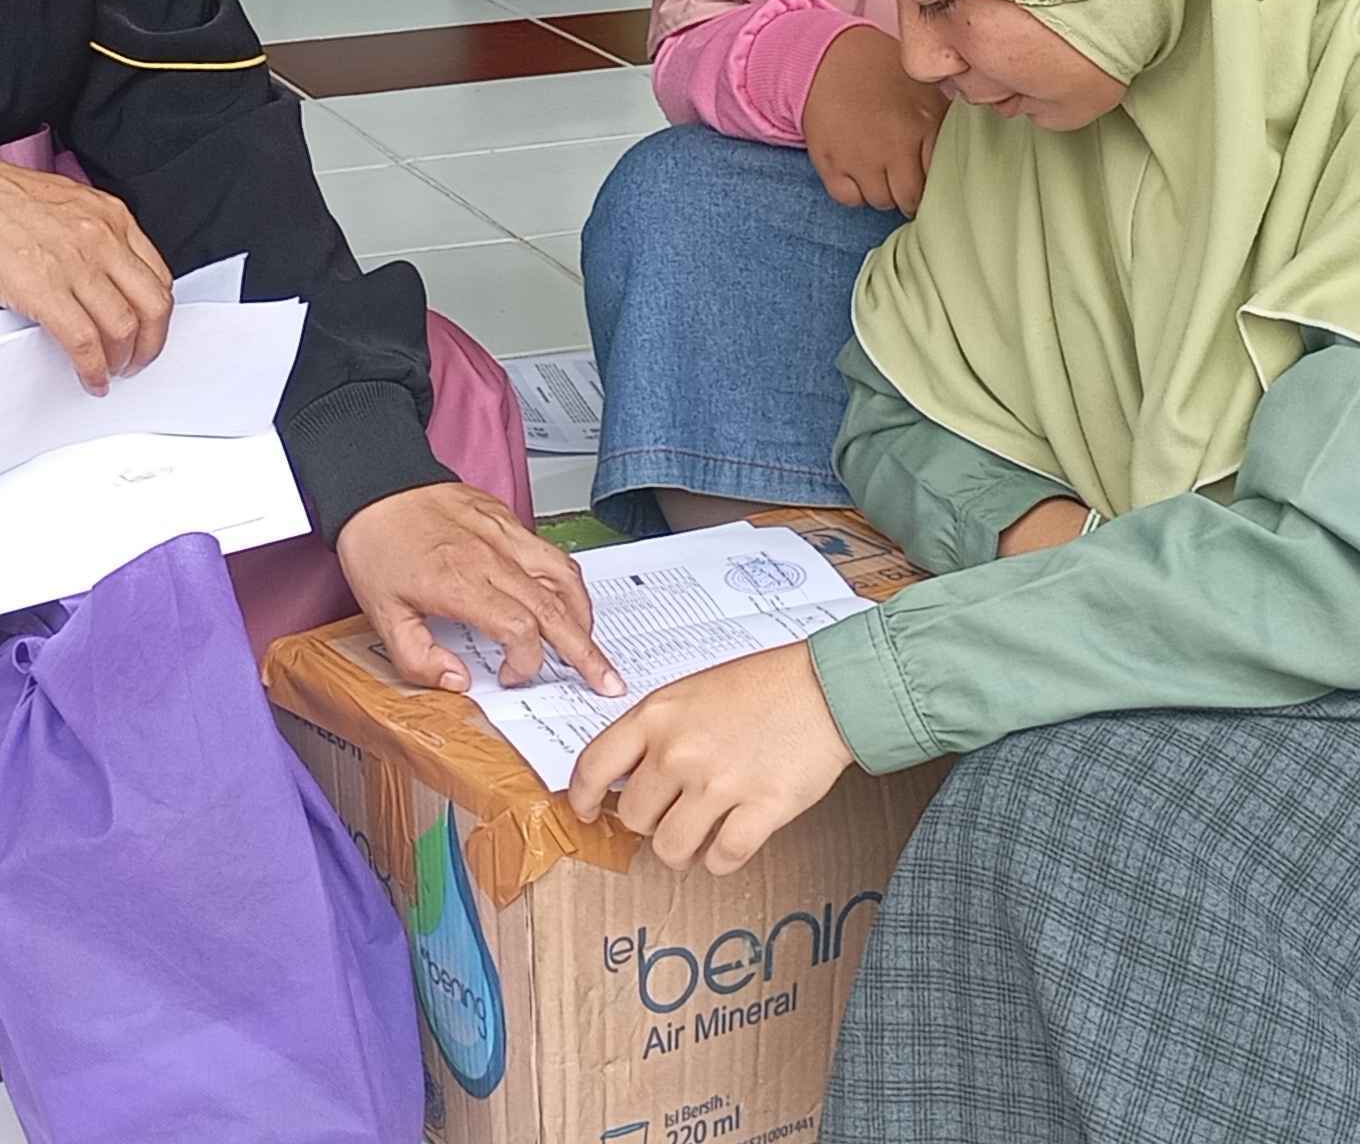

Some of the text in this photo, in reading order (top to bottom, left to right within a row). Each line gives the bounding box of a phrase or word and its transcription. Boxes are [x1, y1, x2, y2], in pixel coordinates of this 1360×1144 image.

[637, 891, 883, 1014] benin
[642, 982, 798, 1060] Air Mineral
[713, 1103, 740, 1137] ml
